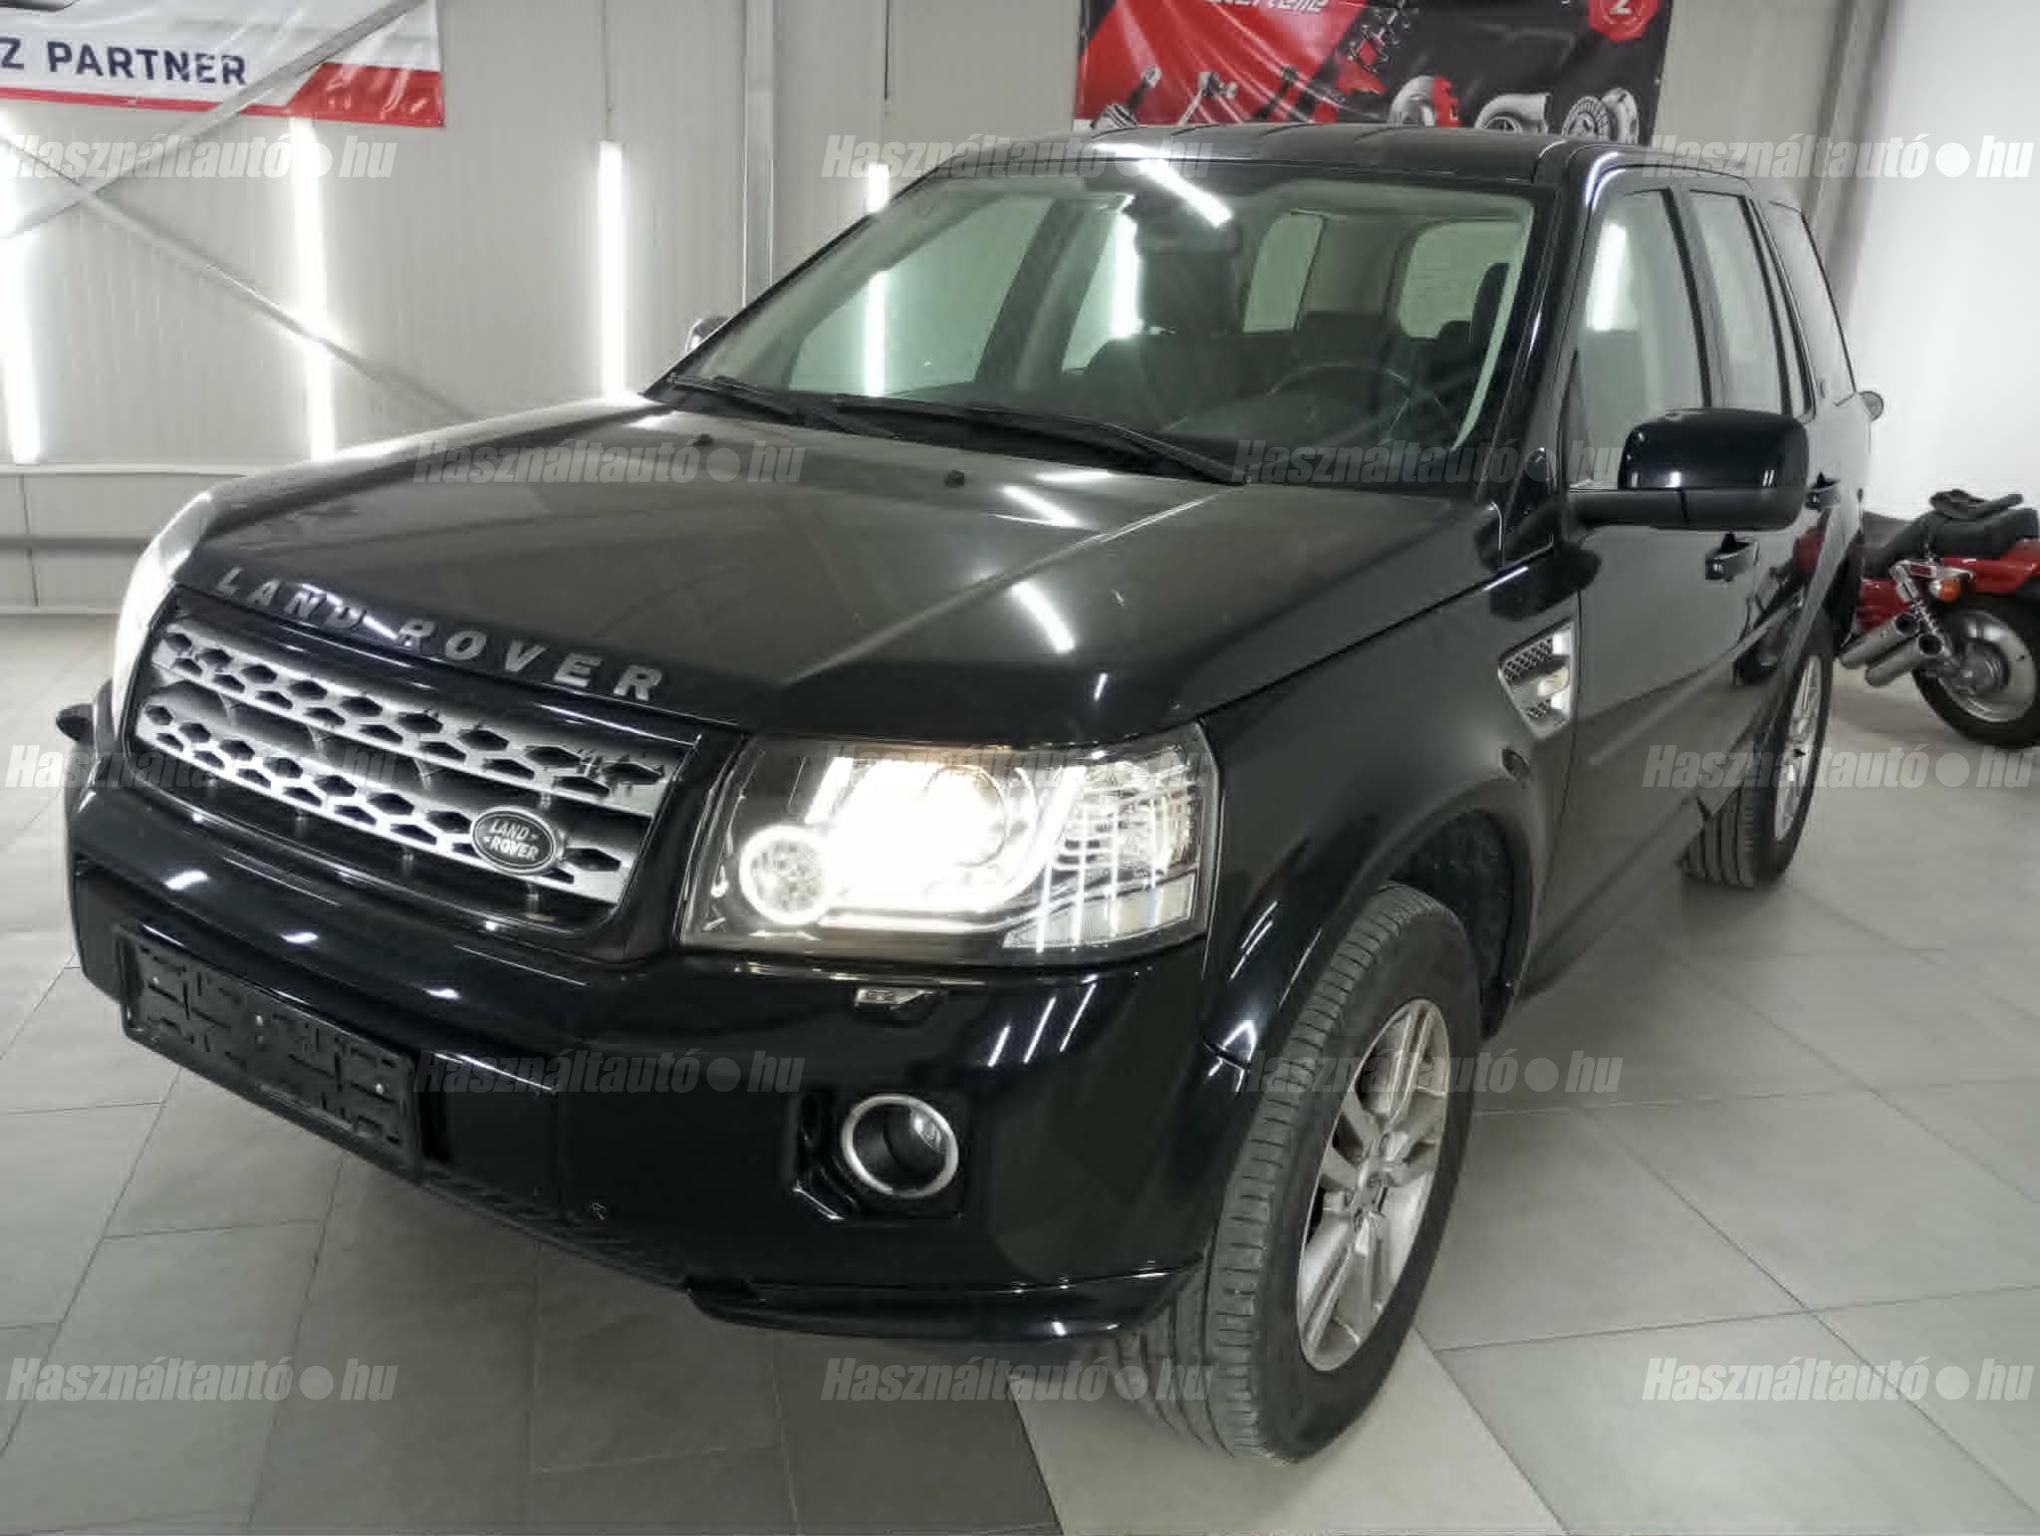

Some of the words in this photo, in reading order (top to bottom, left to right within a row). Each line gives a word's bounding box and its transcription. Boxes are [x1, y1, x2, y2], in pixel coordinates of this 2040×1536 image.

[46, 40, 246, 86] PARTNER
[212, 566, 368, 630] LAND
[397, 617, 662, 701] ROVER
[490, 820, 530, 840] LAND
[490, 836, 539, 860] ROVER
